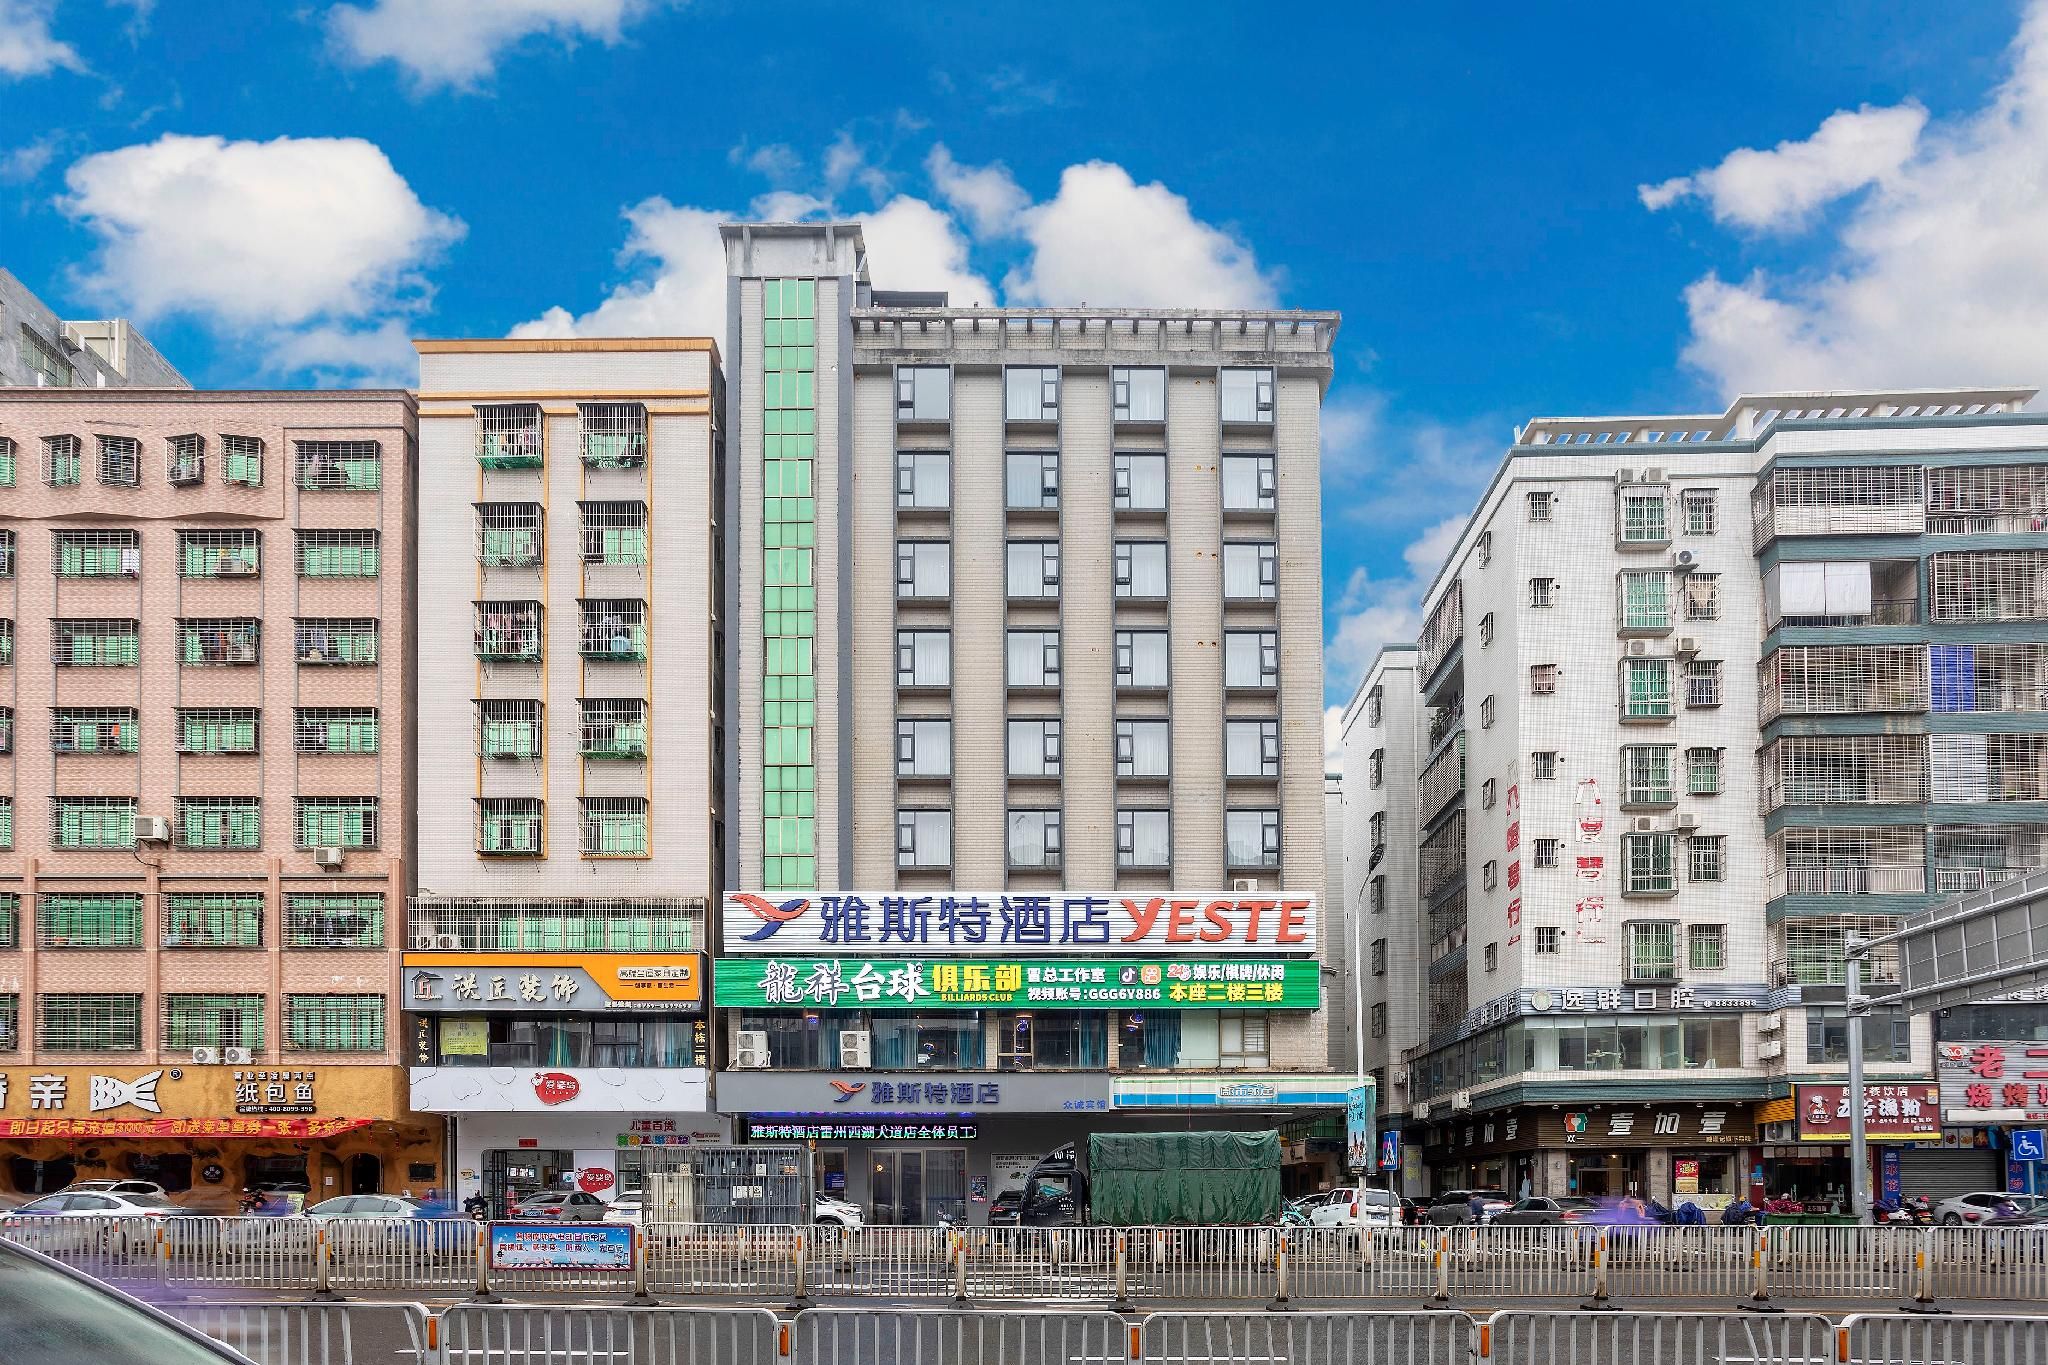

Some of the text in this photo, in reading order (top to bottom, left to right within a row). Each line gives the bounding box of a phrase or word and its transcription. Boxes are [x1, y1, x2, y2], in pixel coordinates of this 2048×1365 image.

[819, 896, 1311, 943] 雅斯特酒店 YESTE
[932, 964, 1022, 993] 俱乐部
[941, 993, 1013, 1002] BILLIARDS CLUB
[1169, 983, 1284, 1003] 本座二楼三楼
[1561, 988, 1697, 1011] 逸群口腔
[235, 1082, 315, 1104] 纸包鱼
[871, 1081, 1000, 1104] 雅斯特酒店
[1063, 1100, 1107, 1111] 众诚宾馆
[1607, 1112, 1727, 1136] 壹加壹
